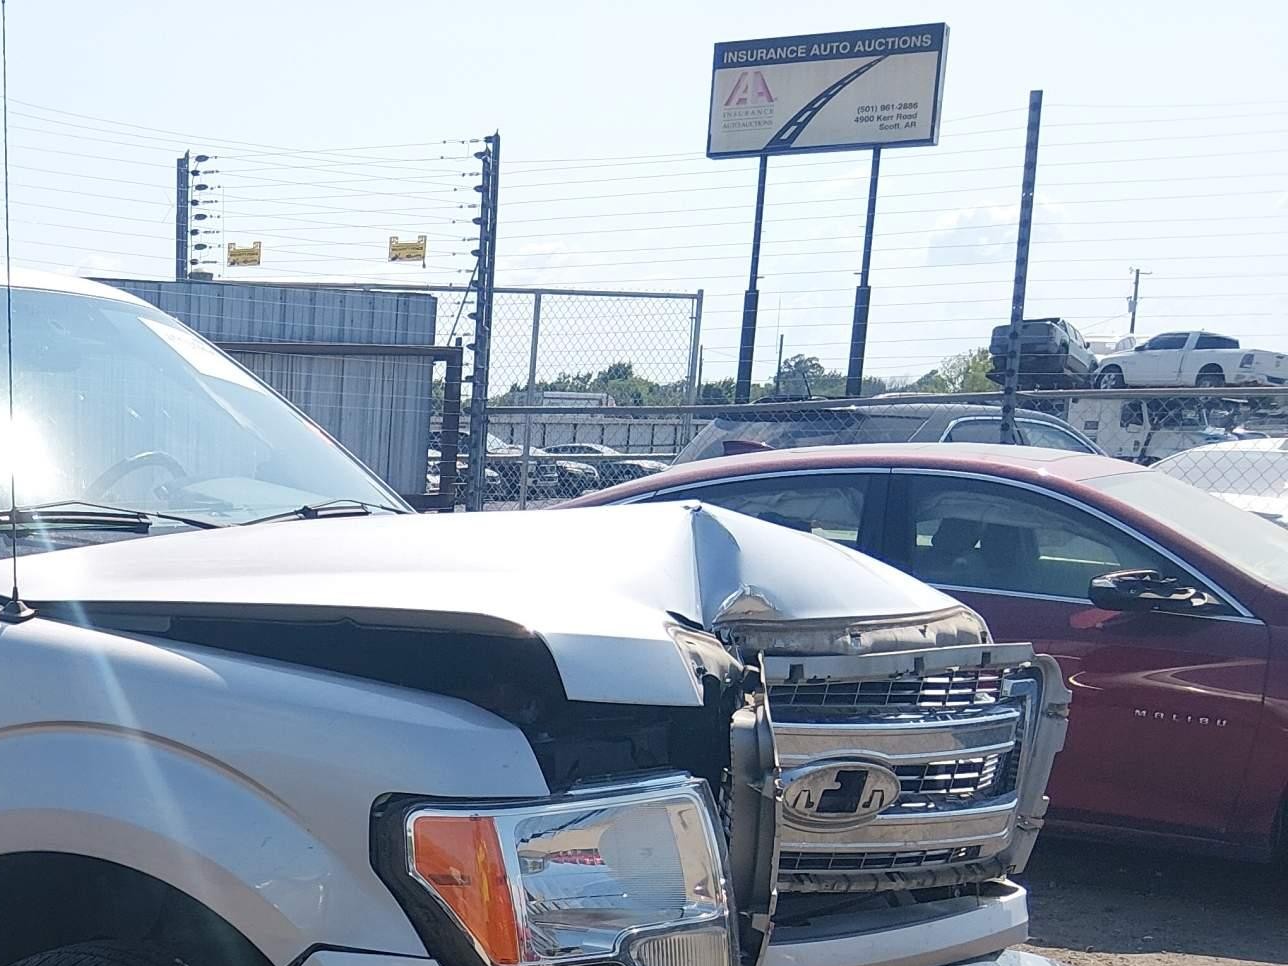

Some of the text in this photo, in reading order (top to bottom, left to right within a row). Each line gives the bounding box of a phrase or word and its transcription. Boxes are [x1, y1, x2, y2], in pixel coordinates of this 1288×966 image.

[723, 34, 932, 64] INSURANCE AUTO AUCTIONS
[1134, 709, 1228, 727] MALIBU
